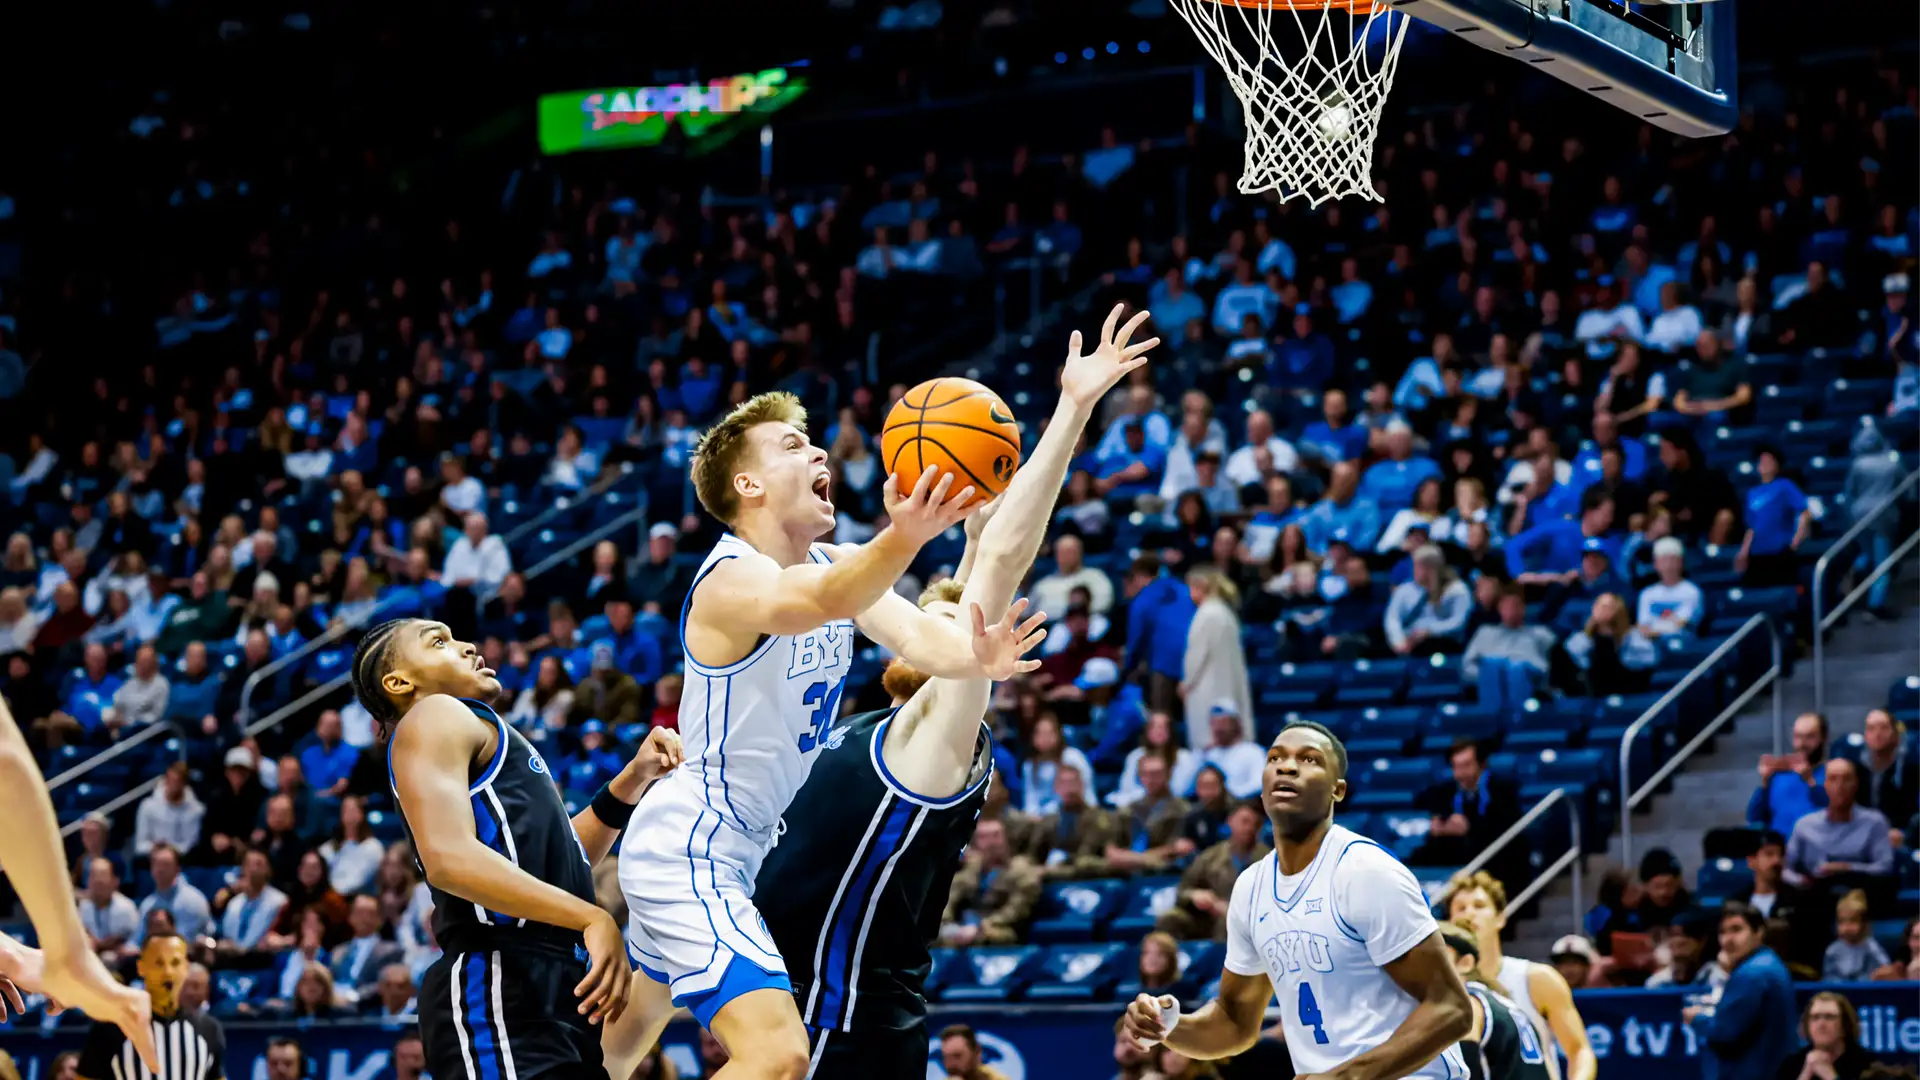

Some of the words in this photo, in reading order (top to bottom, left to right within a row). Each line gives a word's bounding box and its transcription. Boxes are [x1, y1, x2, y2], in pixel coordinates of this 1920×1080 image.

[1261, 930, 1334, 983] BYU
[1298, 982, 1329, 1044] 4
[1622, 1017, 1673, 1056] tv
